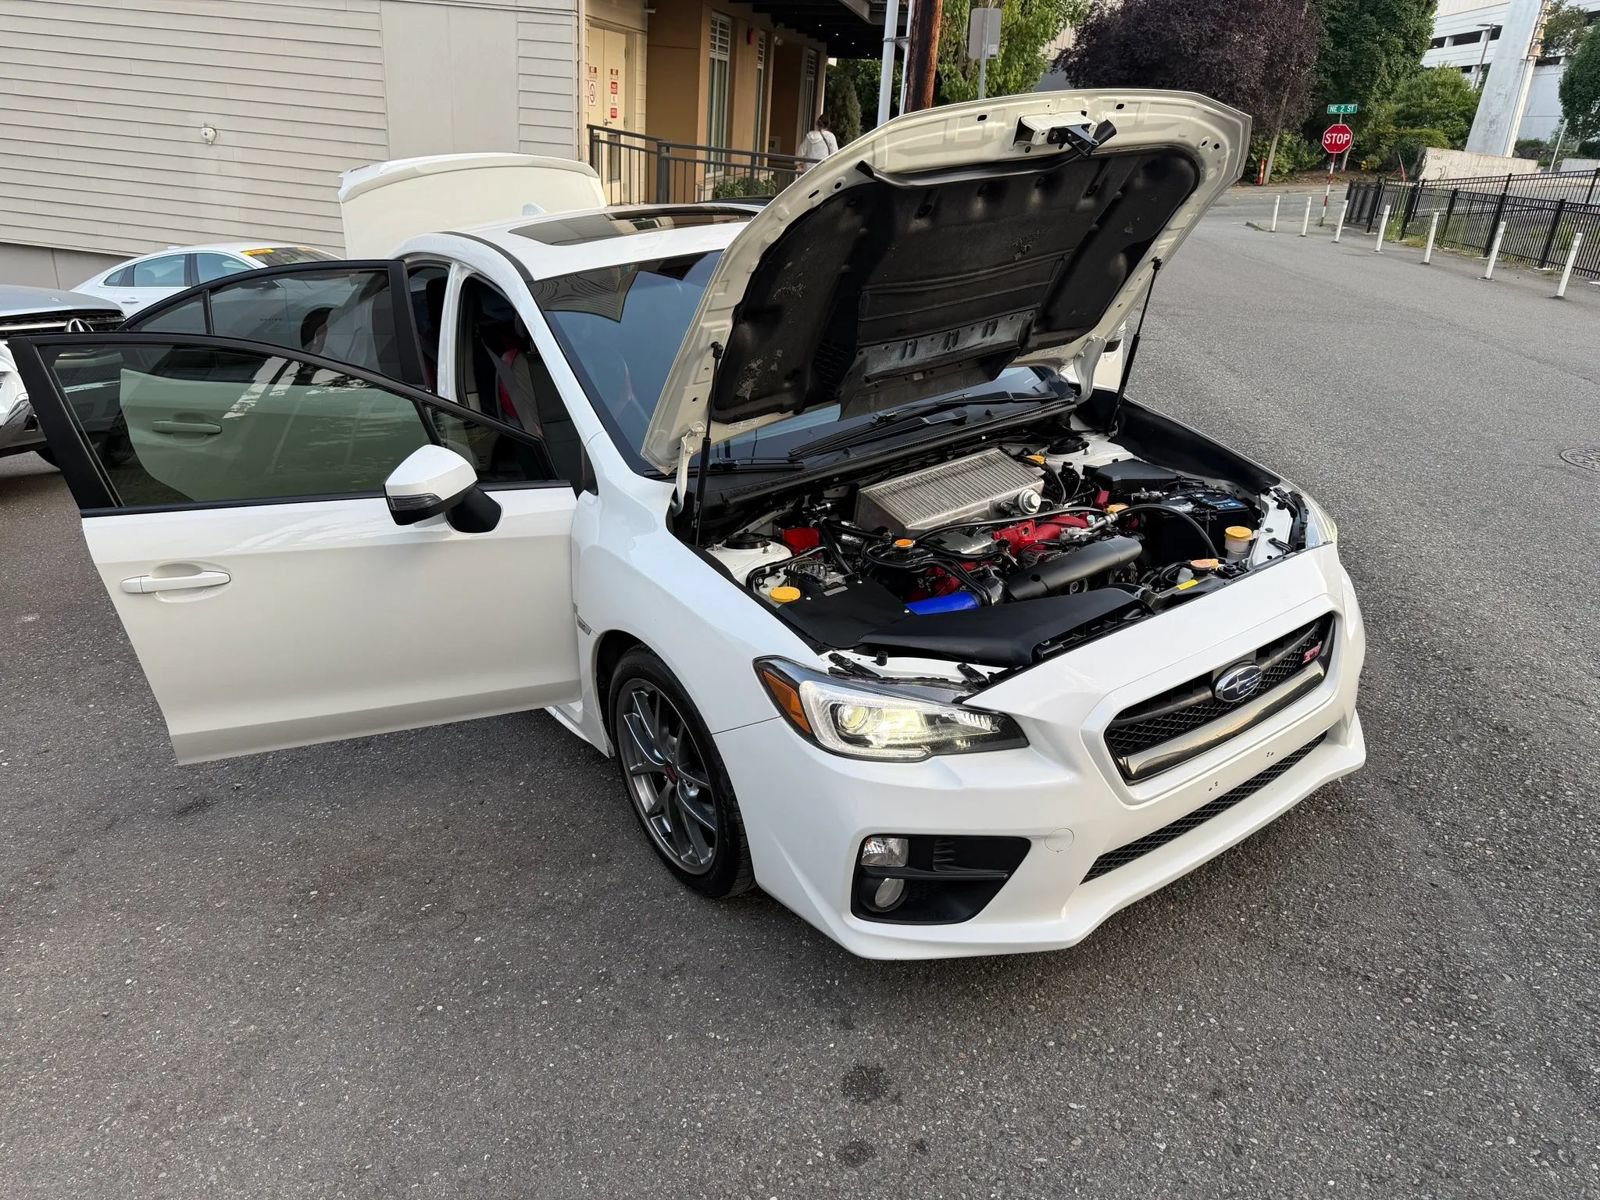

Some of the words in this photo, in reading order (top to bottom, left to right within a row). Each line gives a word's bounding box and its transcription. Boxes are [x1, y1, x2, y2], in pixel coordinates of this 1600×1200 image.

[1329, 105, 1338, 113] NE
[1340, 105, 1345, 113] 2
[1347, 104, 1355, 112] ST
[1324, 133, 1350, 145] STOP
